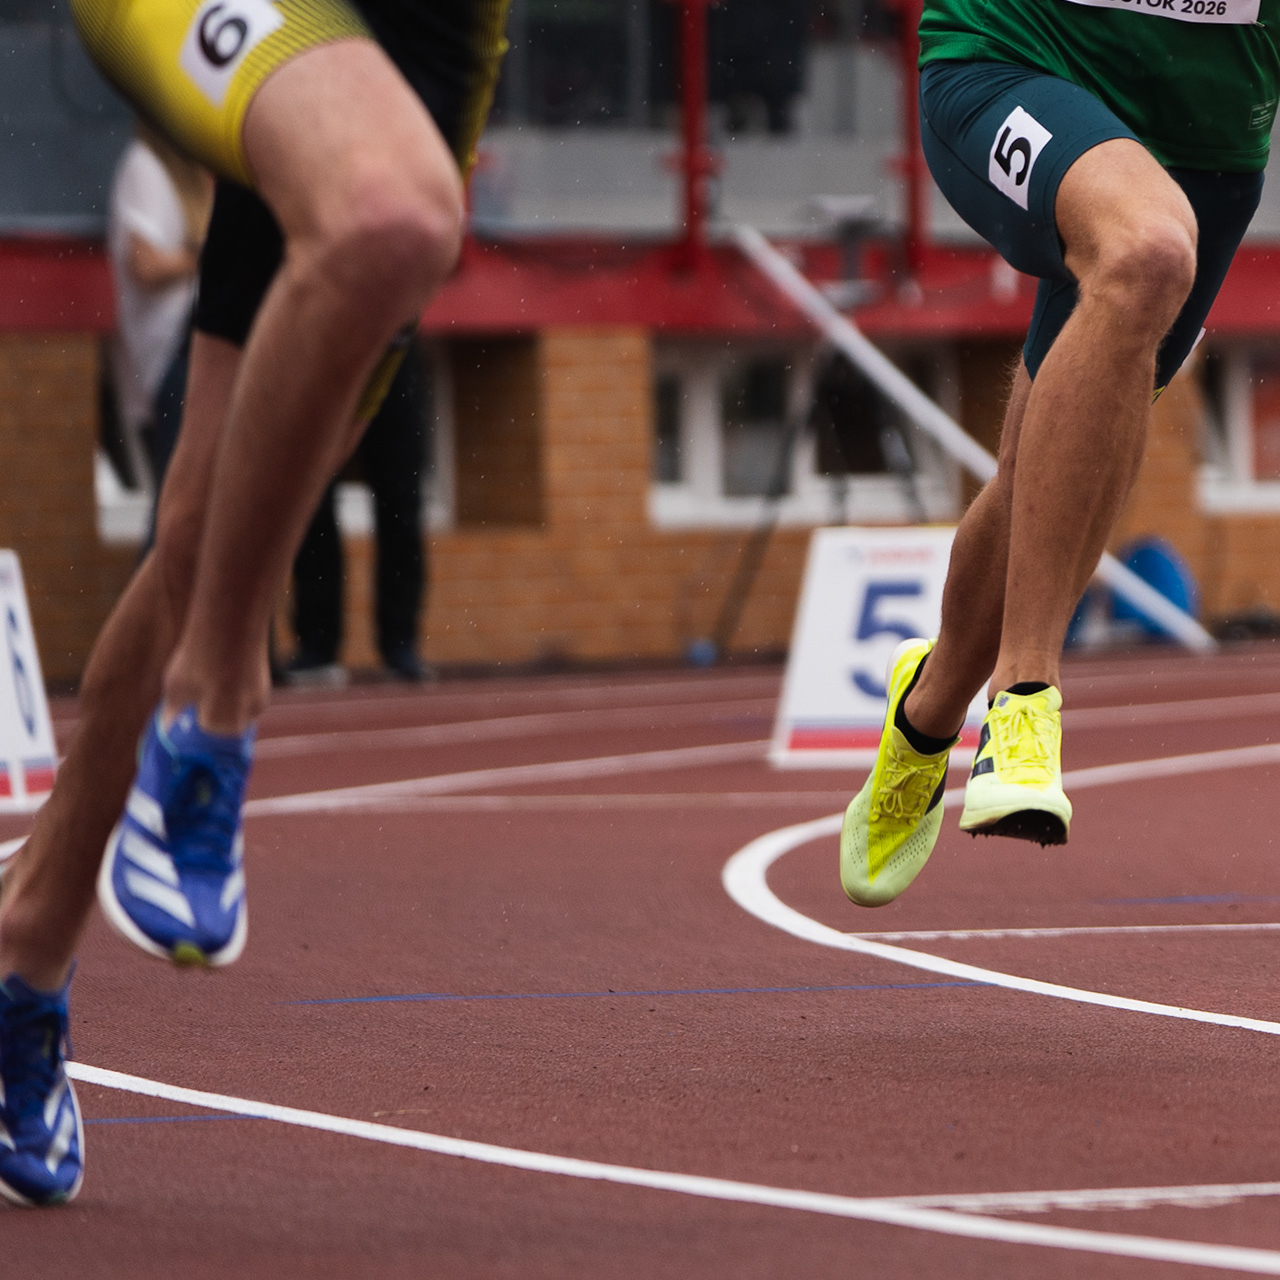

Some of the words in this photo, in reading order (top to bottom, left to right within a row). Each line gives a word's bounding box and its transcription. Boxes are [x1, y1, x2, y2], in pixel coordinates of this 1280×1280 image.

[198, 1, 248, 67] 6
[994, 125, 1032, 186] 5
[850, 581, 928, 699] 5
